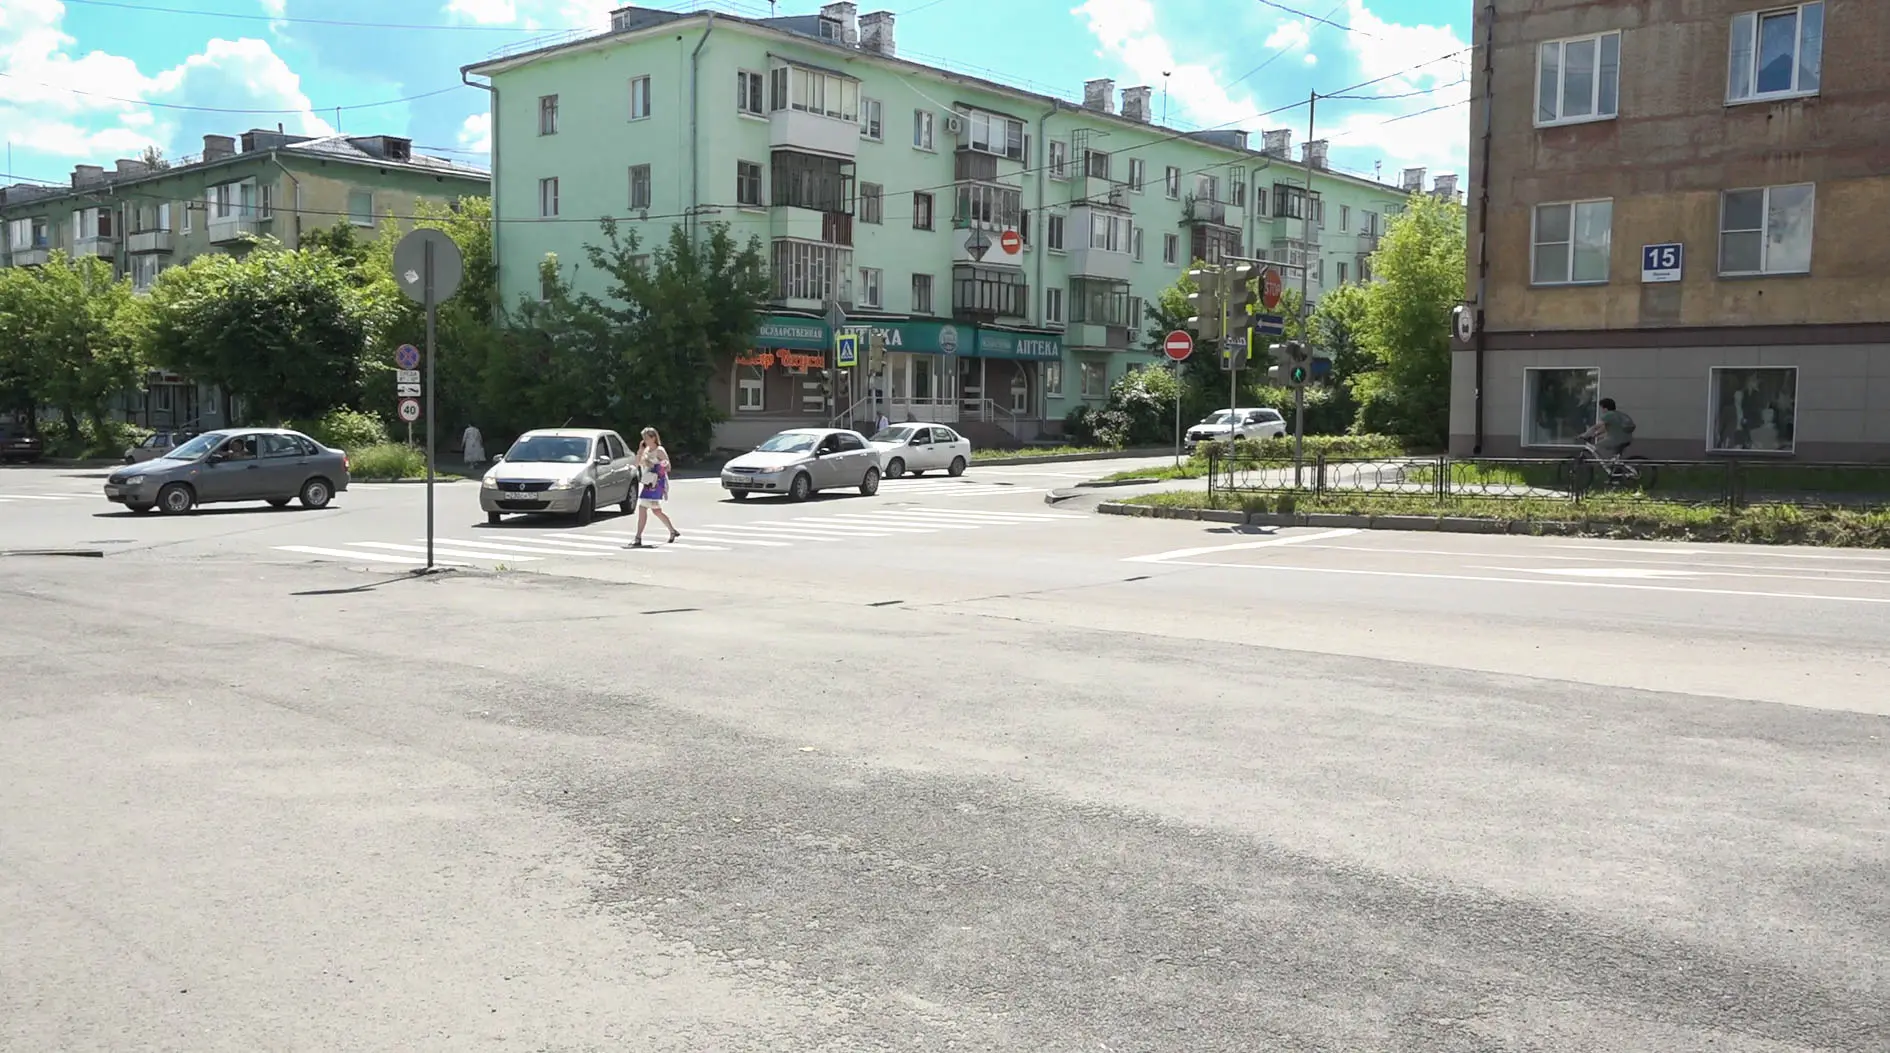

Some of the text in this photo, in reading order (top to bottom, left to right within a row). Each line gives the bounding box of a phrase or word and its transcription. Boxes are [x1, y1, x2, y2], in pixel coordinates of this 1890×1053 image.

[1649, 248, 1675, 268] 15
[1265, 282, 1280, 297] STOP
[759, 326, 823, 339] ОСУДАРСТВЕННАЯ
[834, 328, 903, 346] АТКА
[1016, 339, 1059, 356] АПТЕКА
[403, 405, 416, 416] 40
